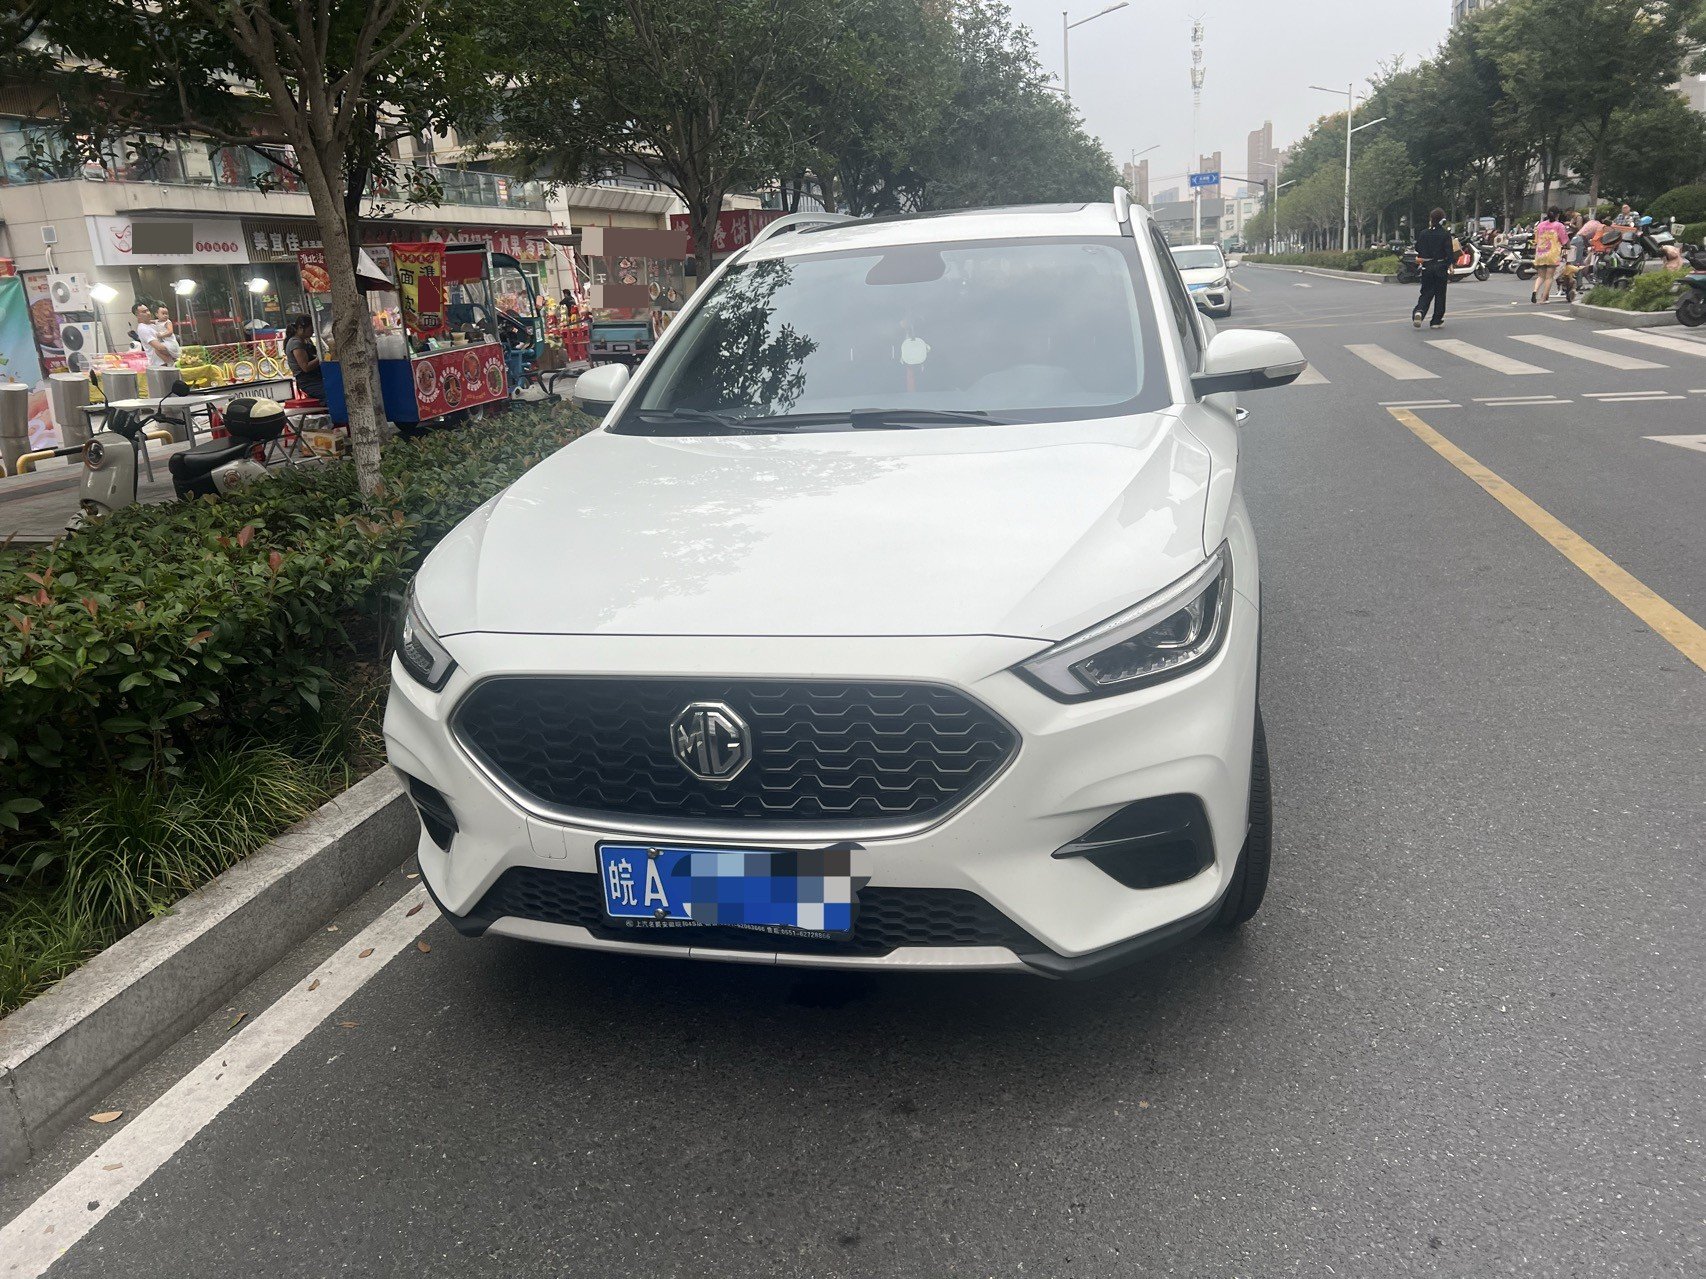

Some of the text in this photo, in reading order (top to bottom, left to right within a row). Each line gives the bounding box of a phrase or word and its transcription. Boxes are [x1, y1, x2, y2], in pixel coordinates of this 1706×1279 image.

[252, 232, 300, 251] 美宜佳
[677, 711, 741, 774] MG
